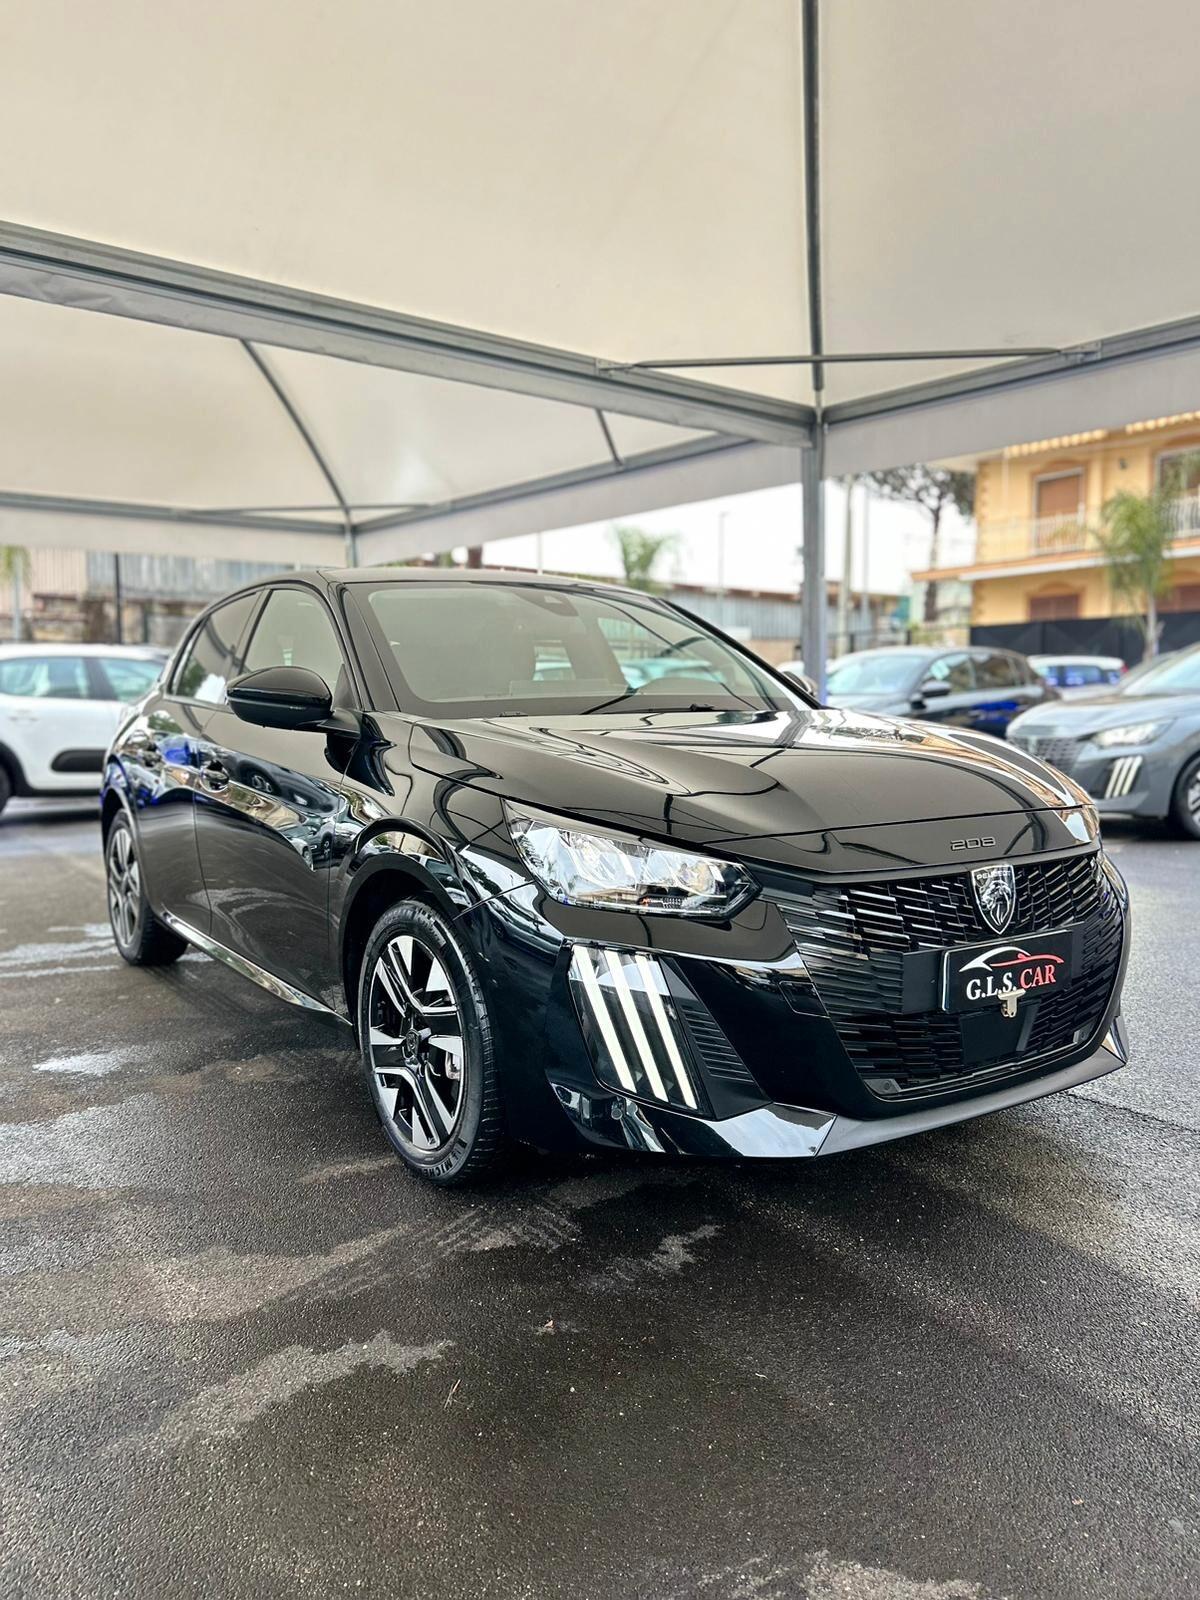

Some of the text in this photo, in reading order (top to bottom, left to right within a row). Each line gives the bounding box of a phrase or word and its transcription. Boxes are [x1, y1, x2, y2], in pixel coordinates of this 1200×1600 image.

[951, 837, 996, 851] 208
[966, 964, 1057, 1000] G.L.S. CAR
[415, 1158, 454, 1178] MICHE
